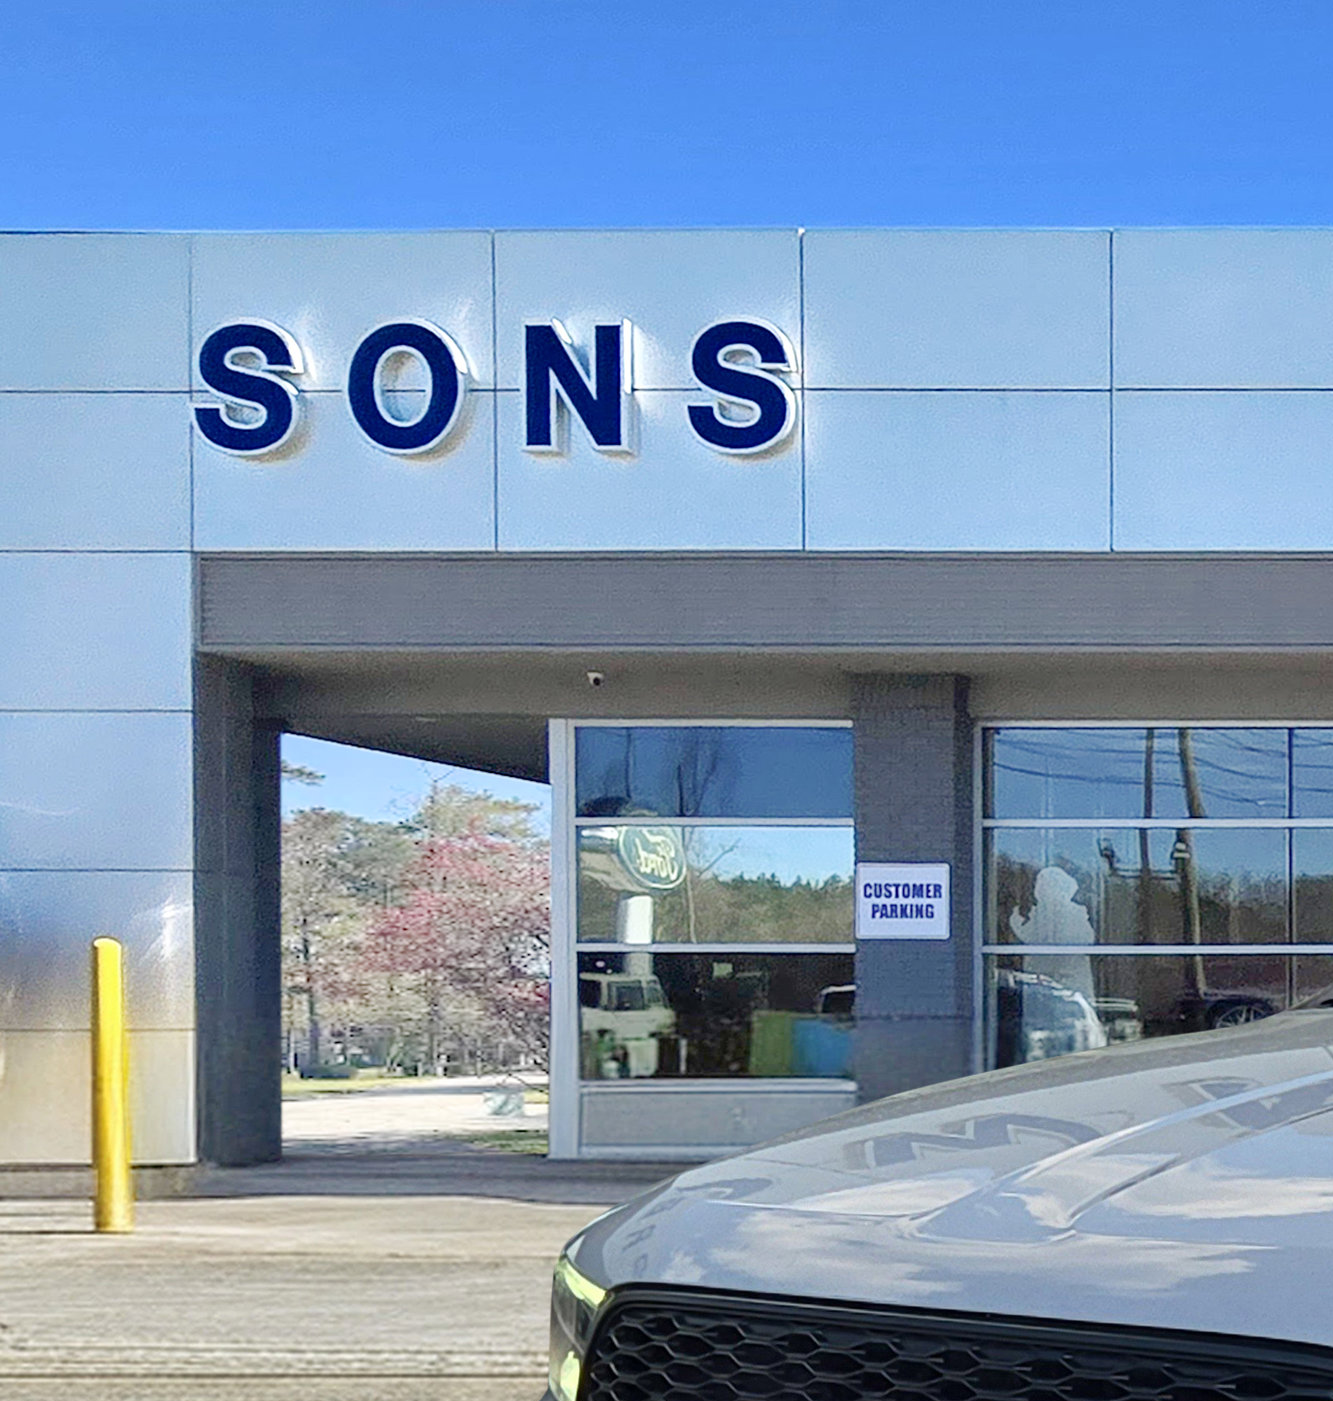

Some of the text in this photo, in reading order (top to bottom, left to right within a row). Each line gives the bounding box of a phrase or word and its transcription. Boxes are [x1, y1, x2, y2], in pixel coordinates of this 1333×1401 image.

[193, 319, 798, 452] SONS
[863, 883, 943, 899] CUSTOMER
[871, 904, 934, 919] PARKING
